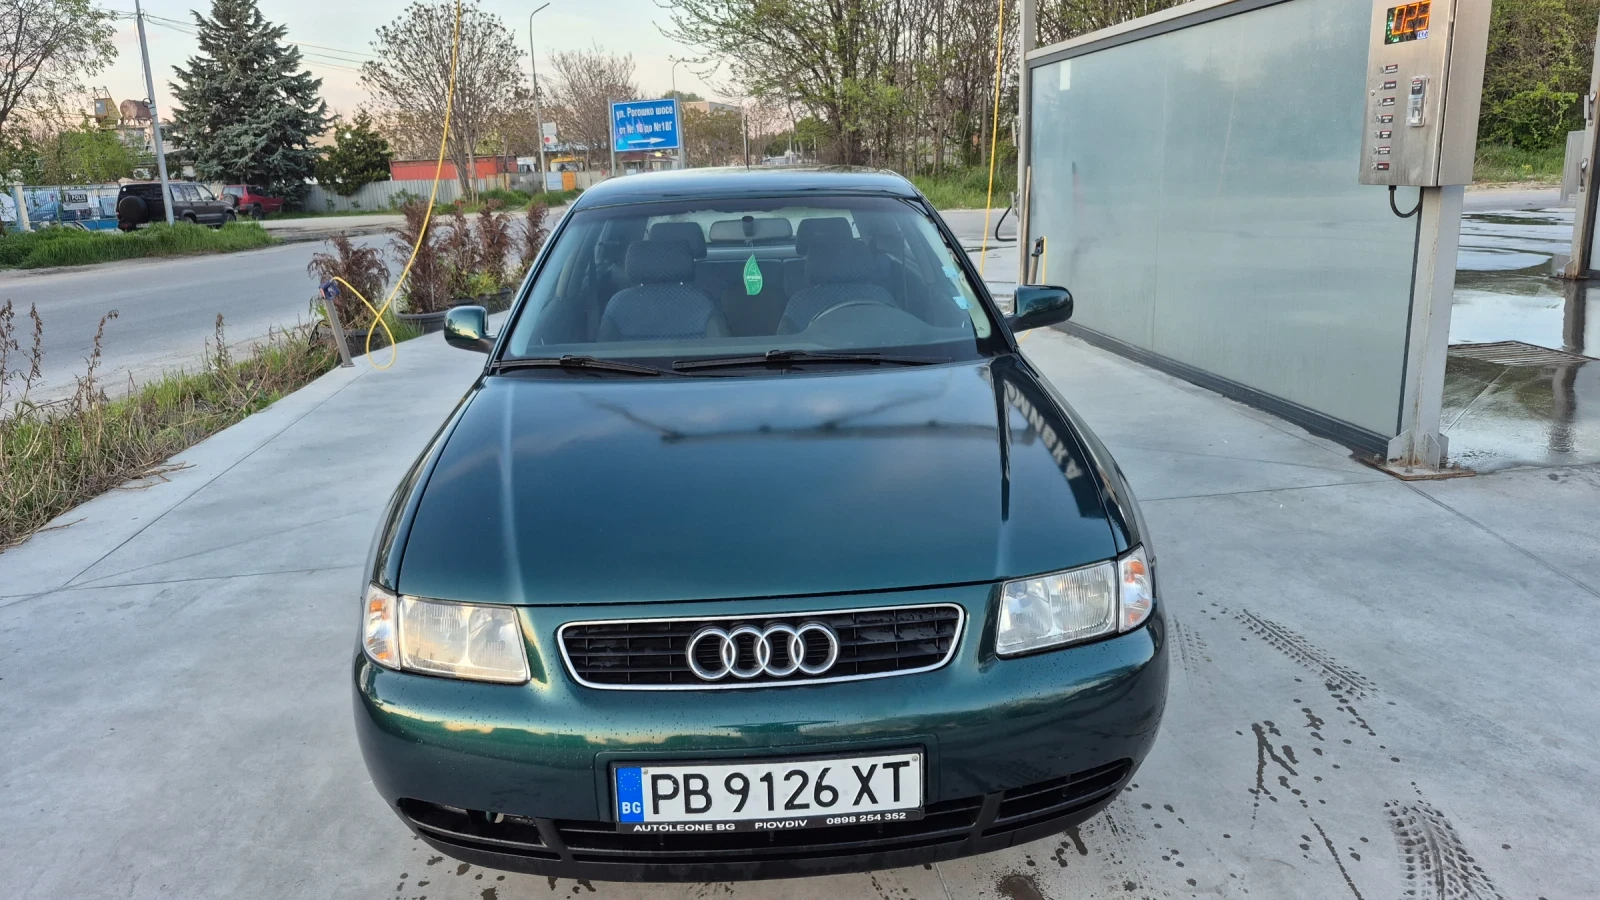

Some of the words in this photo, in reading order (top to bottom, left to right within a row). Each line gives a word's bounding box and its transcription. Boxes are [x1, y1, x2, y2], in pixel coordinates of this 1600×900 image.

[616, 110, 626, 120] ул.
[627, 107, 654, 117] Рогошко
[655, 106, 673, 115] шосе
[619, 127, 626, 135] от
[644, 125, 653, 134] до
[651, 773, 713, 815] PB
[724, 767, 839, 813] 9126
[852, 760, 911, 806] XT
[621, 801, 642, 815] BG
[633, 823, 713, 832] AUTOLEONE
[716, 823, 736, 831] BG
[826, 816, 857, 825] 0898
[859, 814, 882, 823] 254
[884, 812, 907, 820] 352
